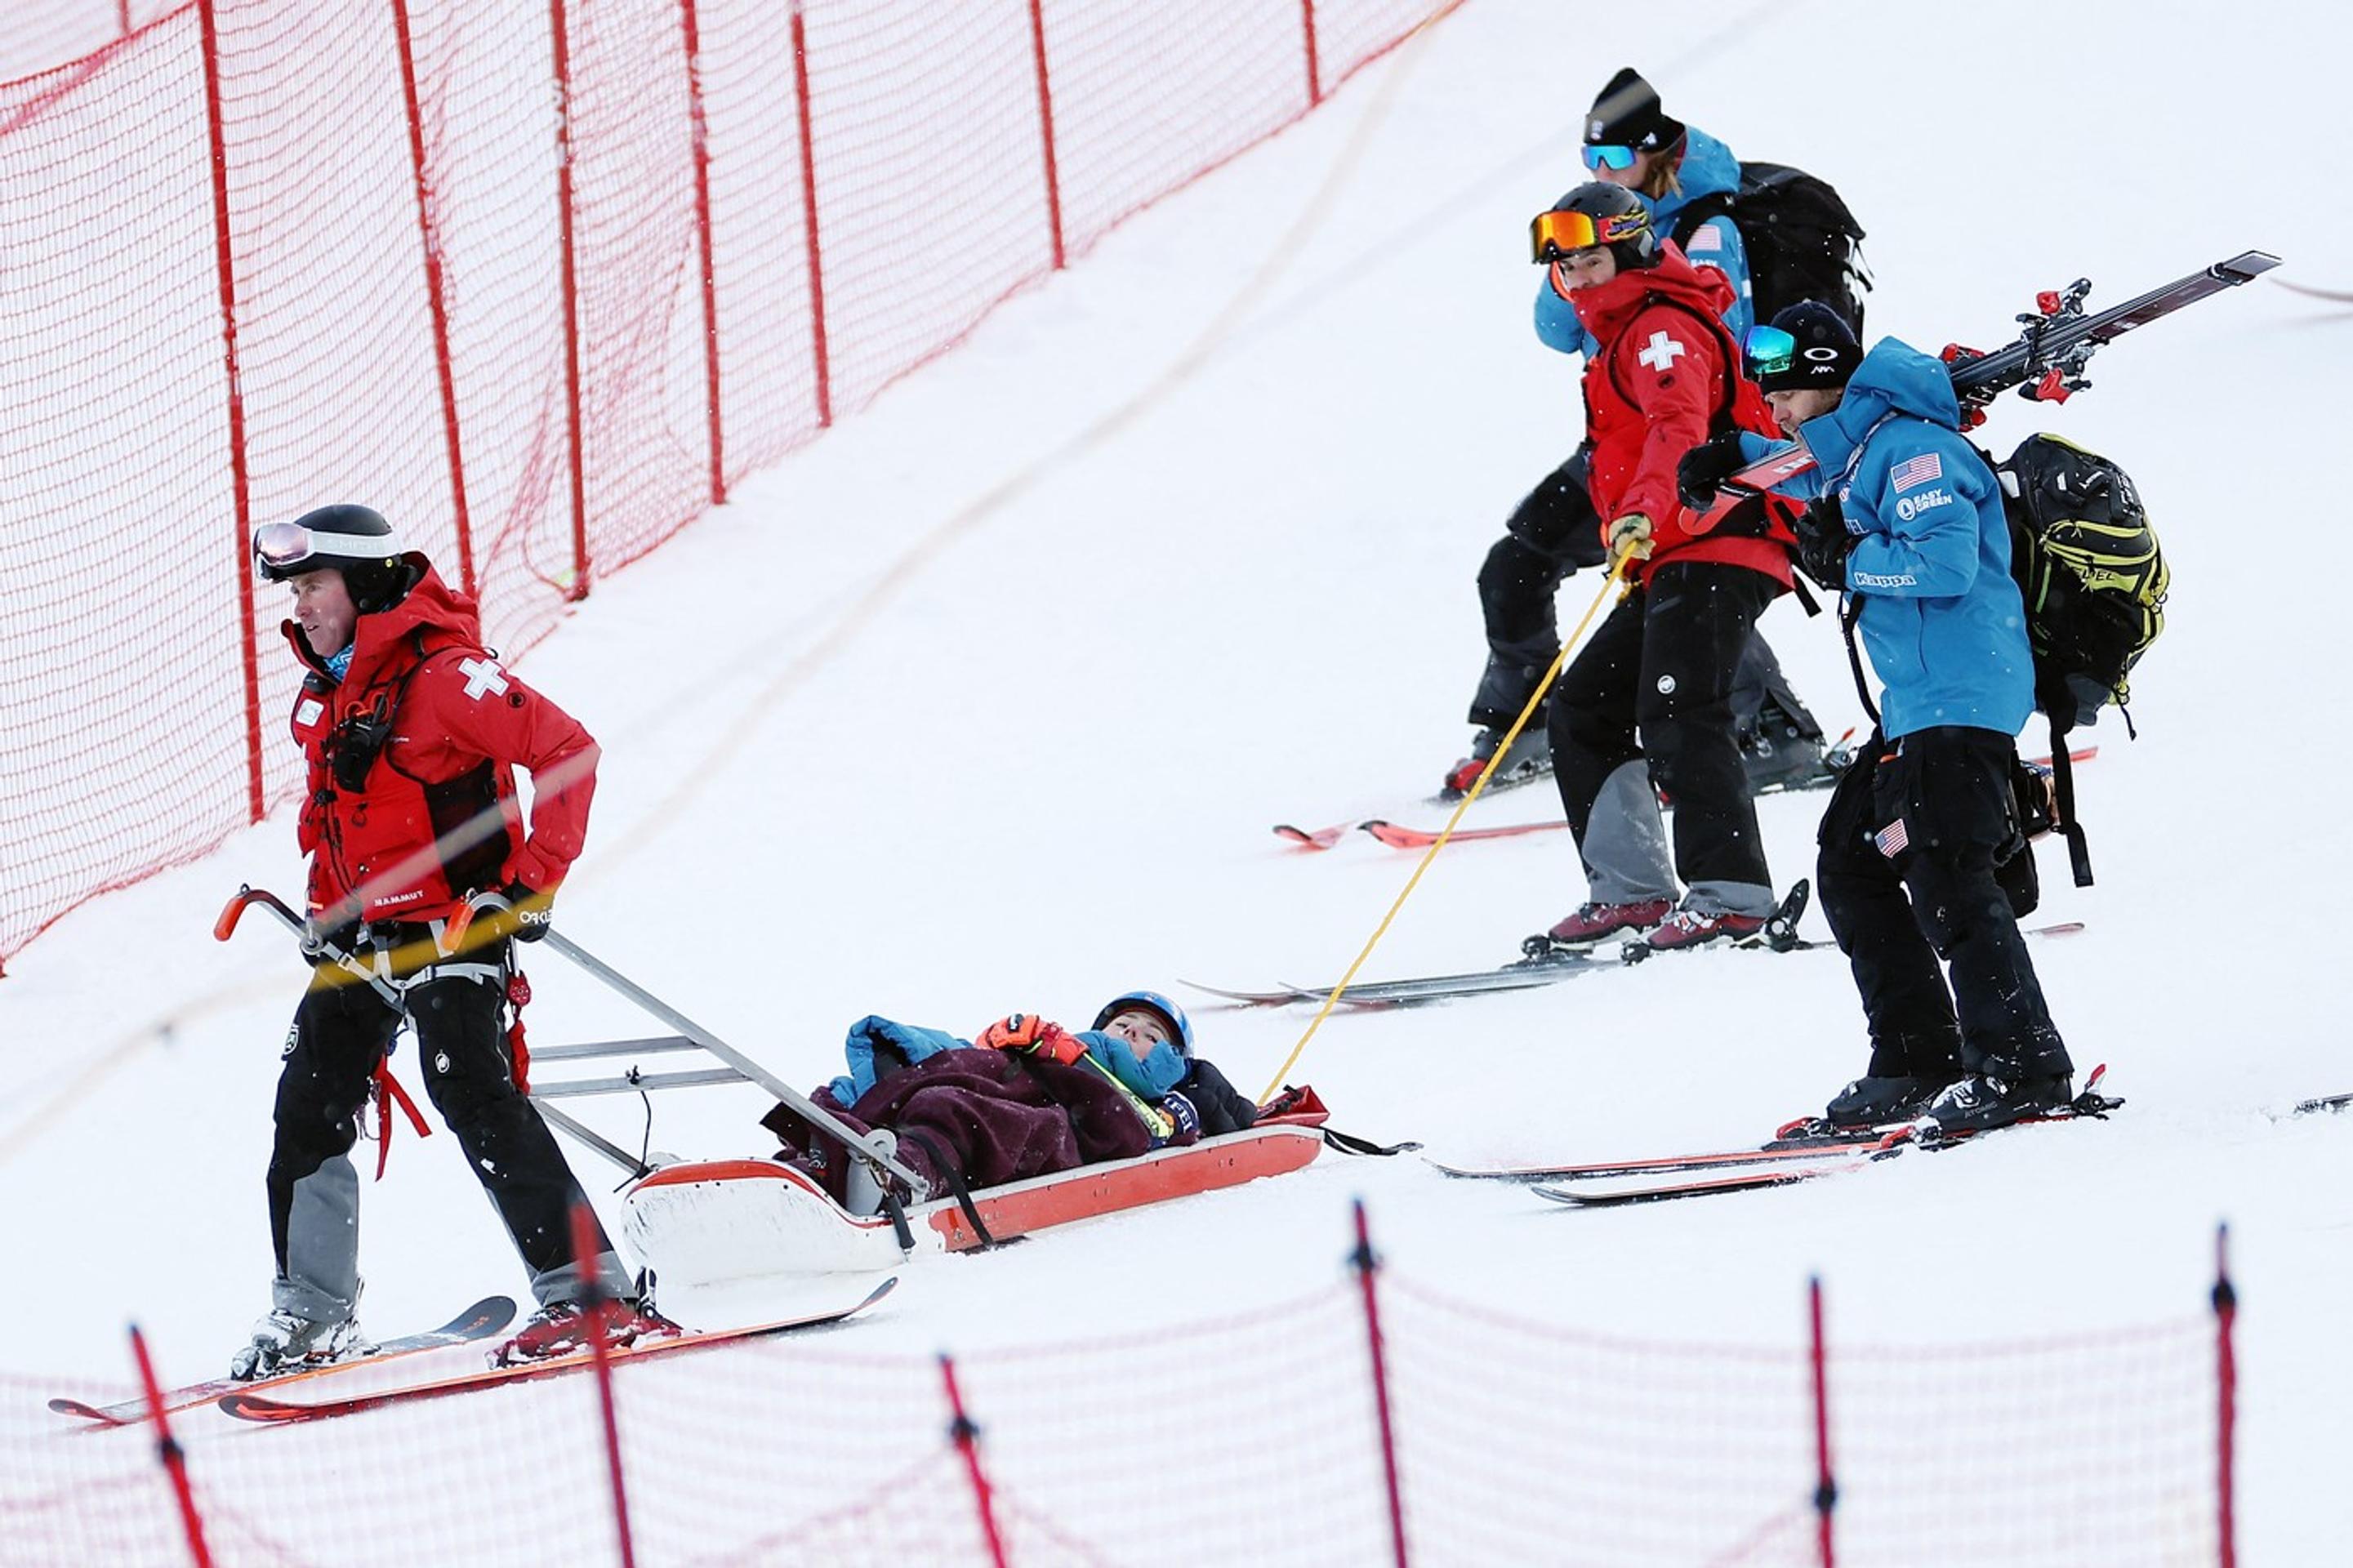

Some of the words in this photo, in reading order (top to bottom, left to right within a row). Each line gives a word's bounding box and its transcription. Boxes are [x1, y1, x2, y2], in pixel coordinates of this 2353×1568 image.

[1914, 488, 1942, 505] EASY
[1916, 494, 1953, 512] GREEN
[1854, 572, 1917, 588] Kappa
[374, 889, 424, 907] MAMMUT
